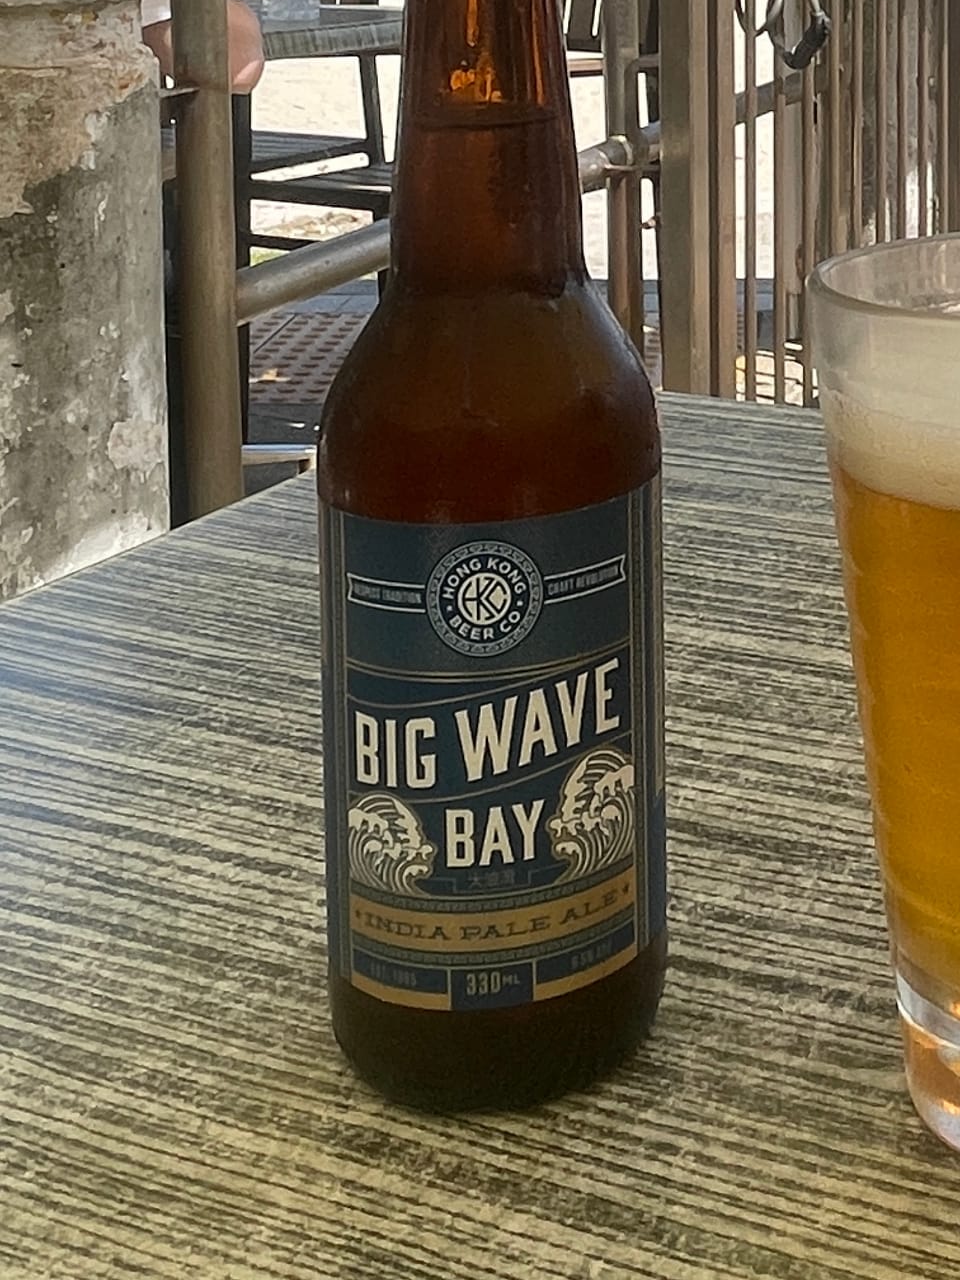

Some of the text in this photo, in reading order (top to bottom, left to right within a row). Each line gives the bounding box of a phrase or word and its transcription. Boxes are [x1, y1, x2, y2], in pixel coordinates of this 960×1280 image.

[441, 557, 527, 600] HONG KONG
[448, 610, 521, 640] BEER CO
[355, 657, 621, 790] BIG WAVE
[445, 798, 546, 868] BAY
[362, 888, 618, 941] INDIA PALE ALE
